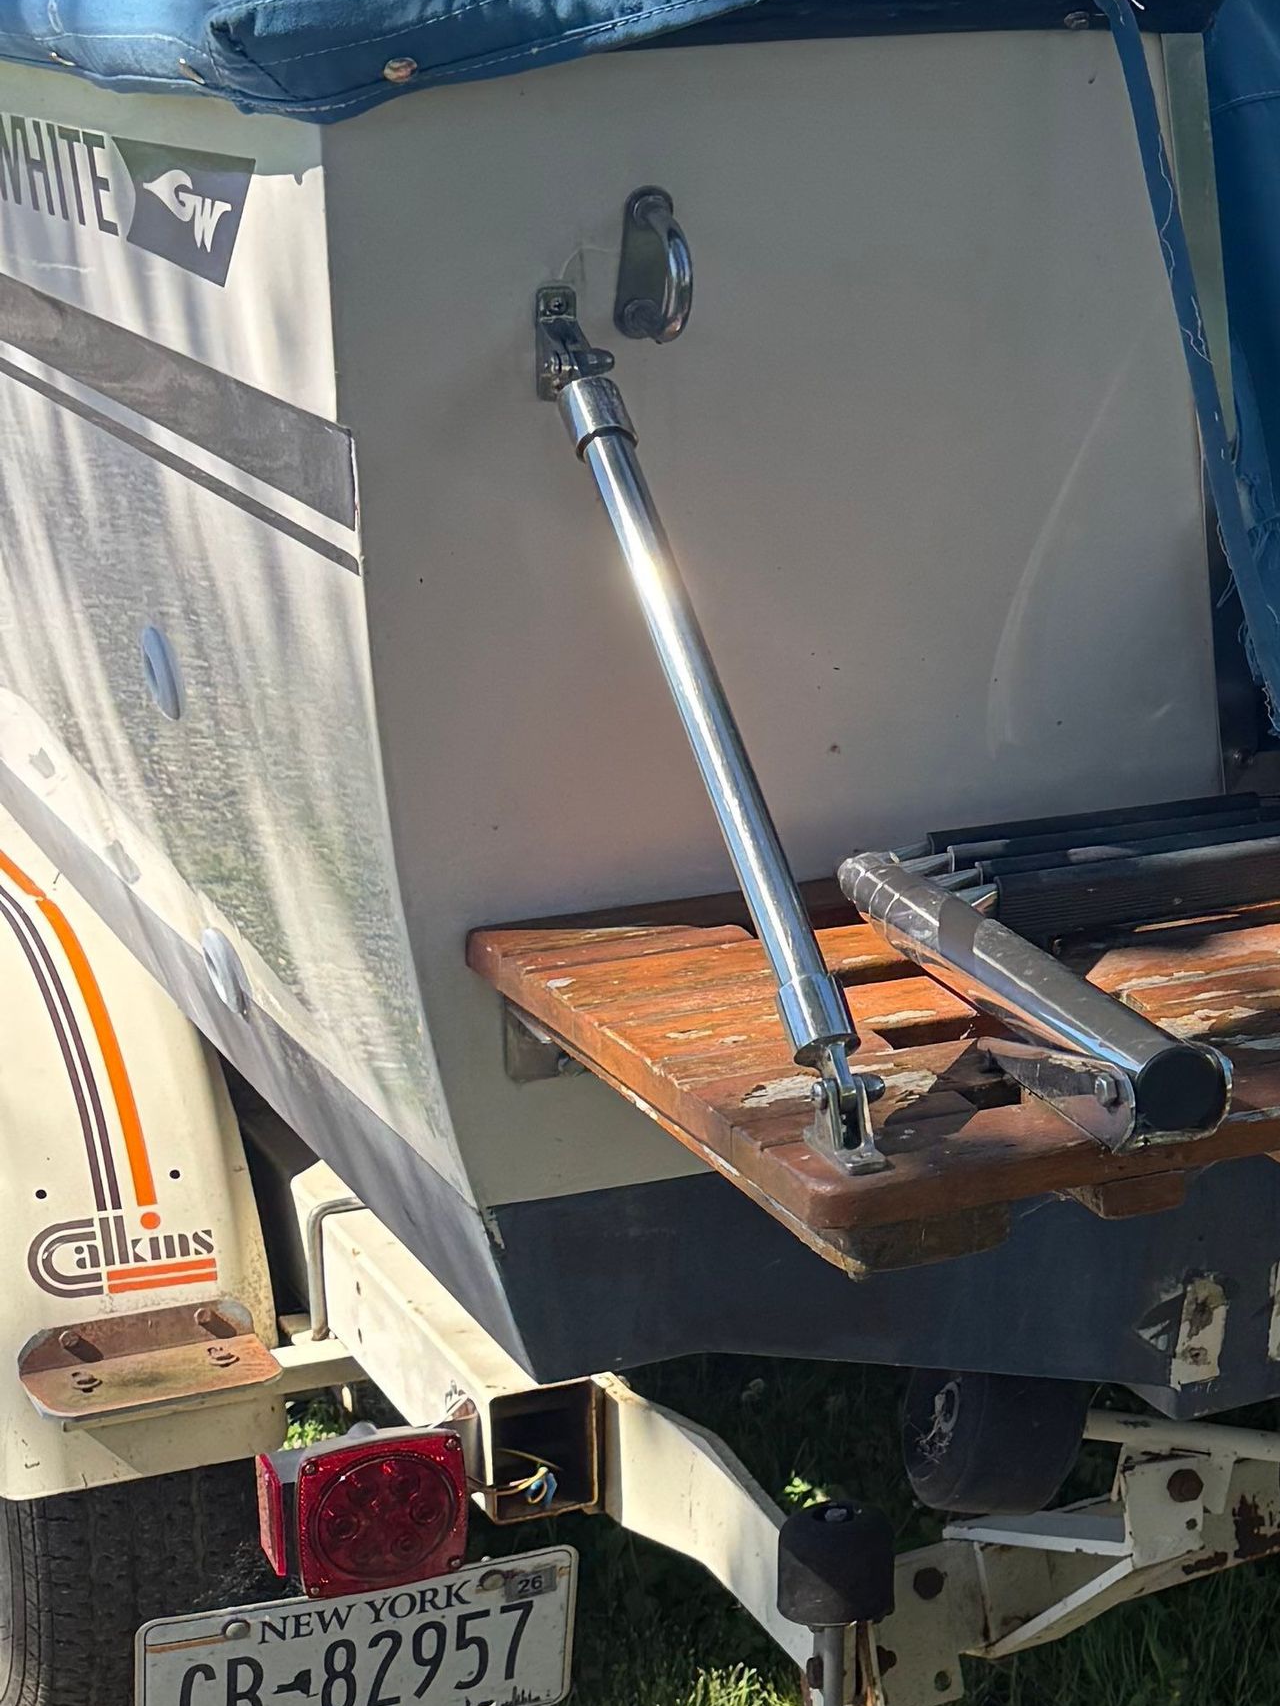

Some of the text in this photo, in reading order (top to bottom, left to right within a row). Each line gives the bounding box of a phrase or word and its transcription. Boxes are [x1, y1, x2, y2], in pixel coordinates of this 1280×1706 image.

[27, 1211, 215, 1299] Calkins
[258, 1579, 474, 1645] NEW YORK
[517, 1574, 543, 1594] 26
